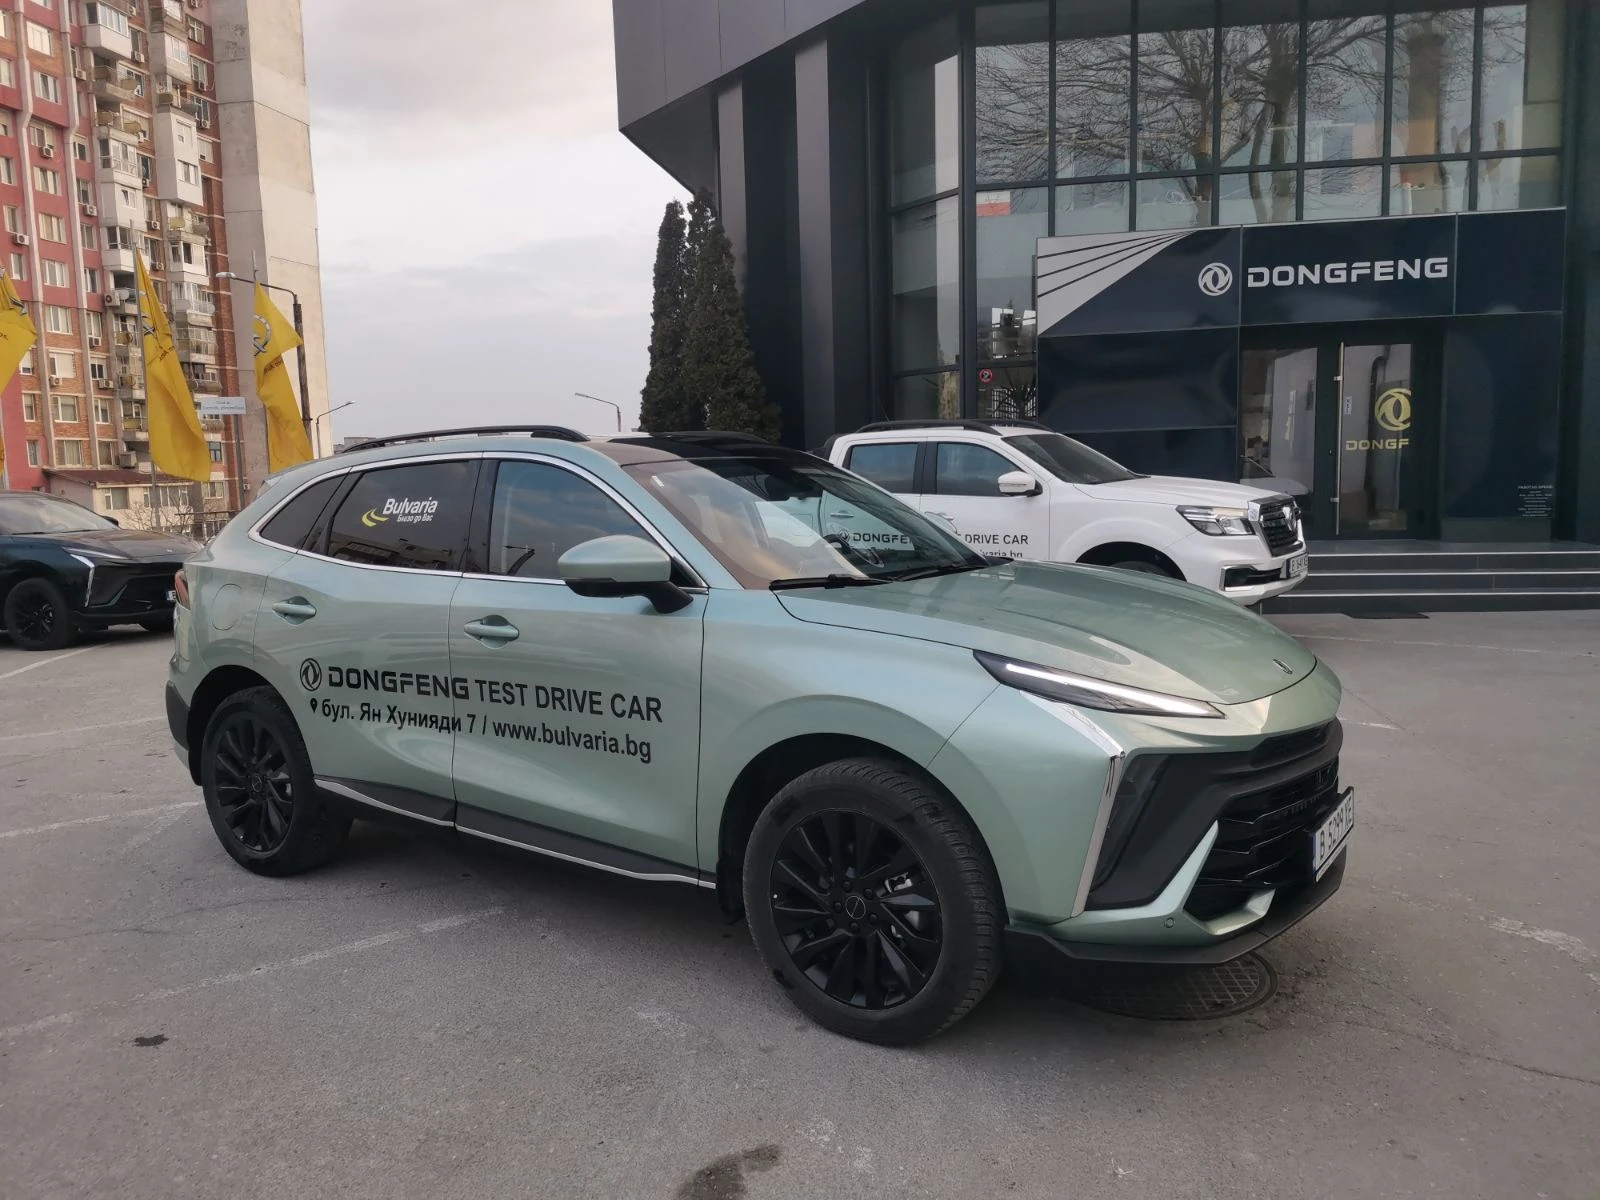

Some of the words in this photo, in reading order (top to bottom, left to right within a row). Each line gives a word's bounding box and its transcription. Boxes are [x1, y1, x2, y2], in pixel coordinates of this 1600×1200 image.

[1248, 258, 1448, 287] DONGFENG
[382, 497, 438, 515] Bulvaria
[853, 533, 912, 544] DONGFE
[965, 534, 999, 545] DRIVE
[1003, 534, 1029, 545] CAR
[328, 666, 470, 700] DONGFENG
[475, 679, 529, 707] TEST
[535, 685, 604, 716] DRIVE
[610, 693, 663, 723] CAR
[321, 699, 355, 723] бул.
[359, 702, 382, 723] Ян
[386, 704, 462, 734] Хунияди
[467, 713, 477, 734] 7
[492, 719, 652, 764] www.bulvaria.bg
